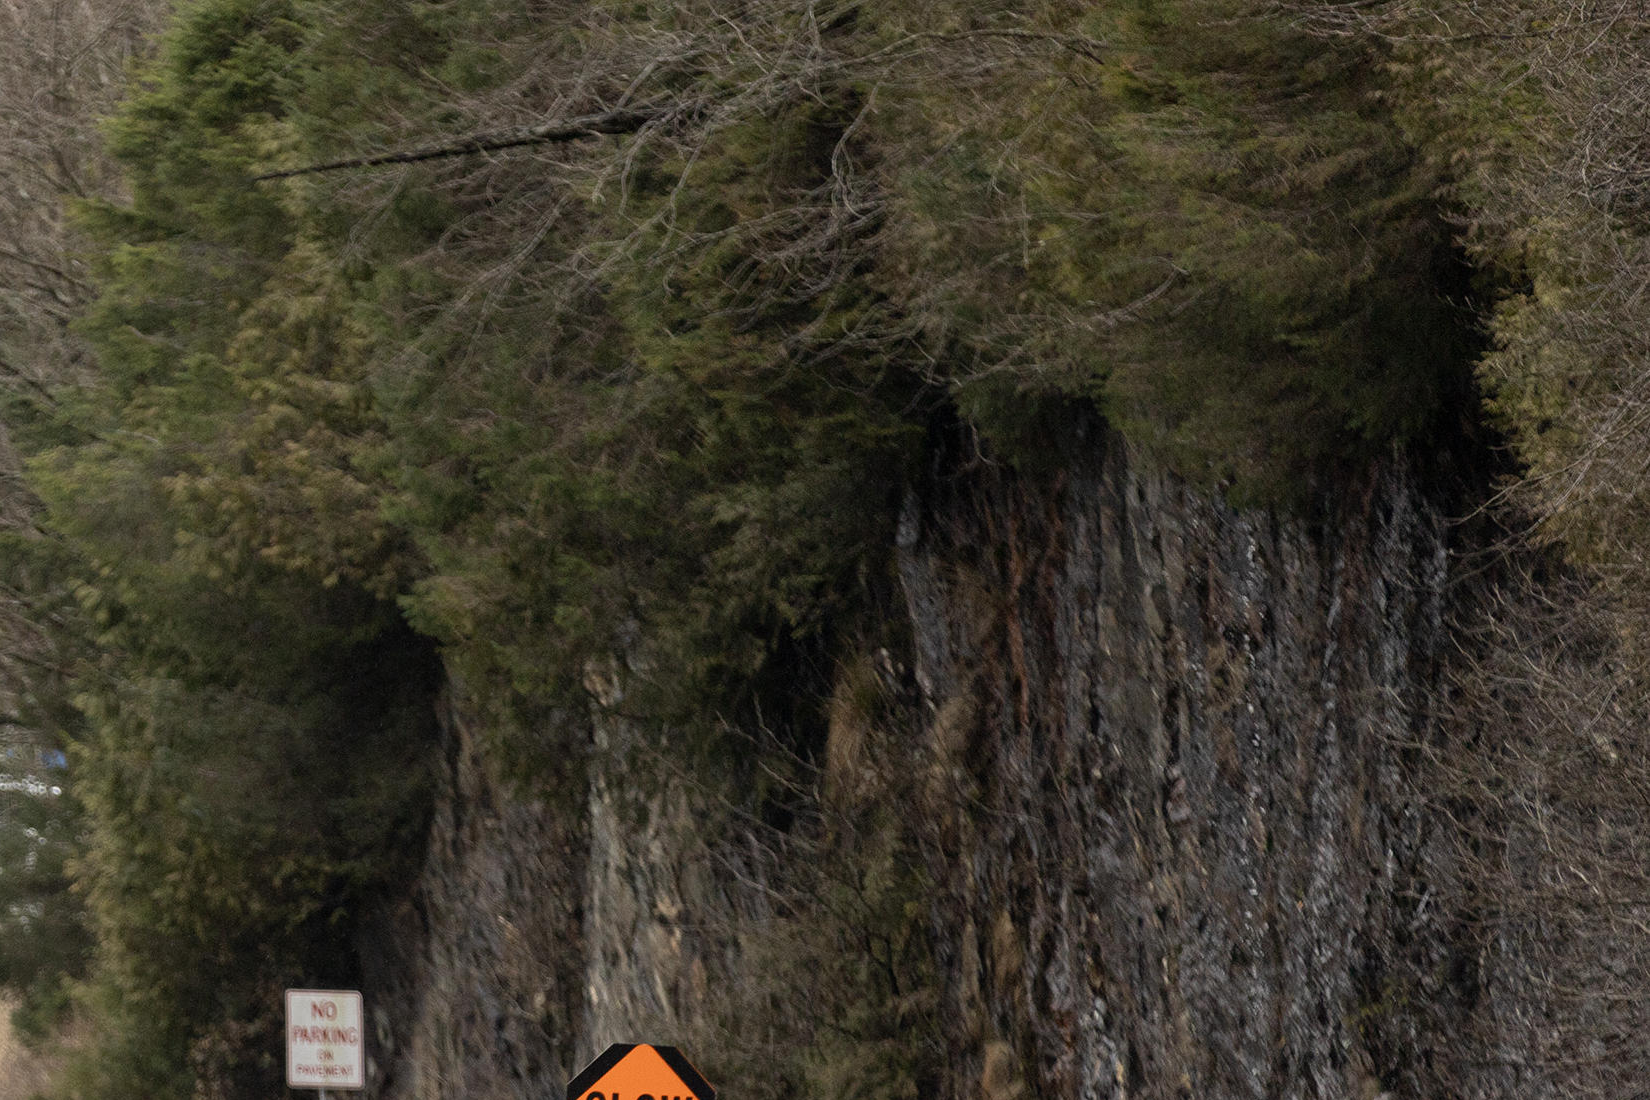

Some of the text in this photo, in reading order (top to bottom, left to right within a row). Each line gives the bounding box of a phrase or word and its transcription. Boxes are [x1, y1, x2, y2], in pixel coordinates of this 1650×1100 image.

[311, 1000, 338, 1021] NO
[292, 1025, 358, 1046] PARKING
[316, 1049, 334, 1062] ON
[296, 1064, 353, 1078] PAVEMENT
